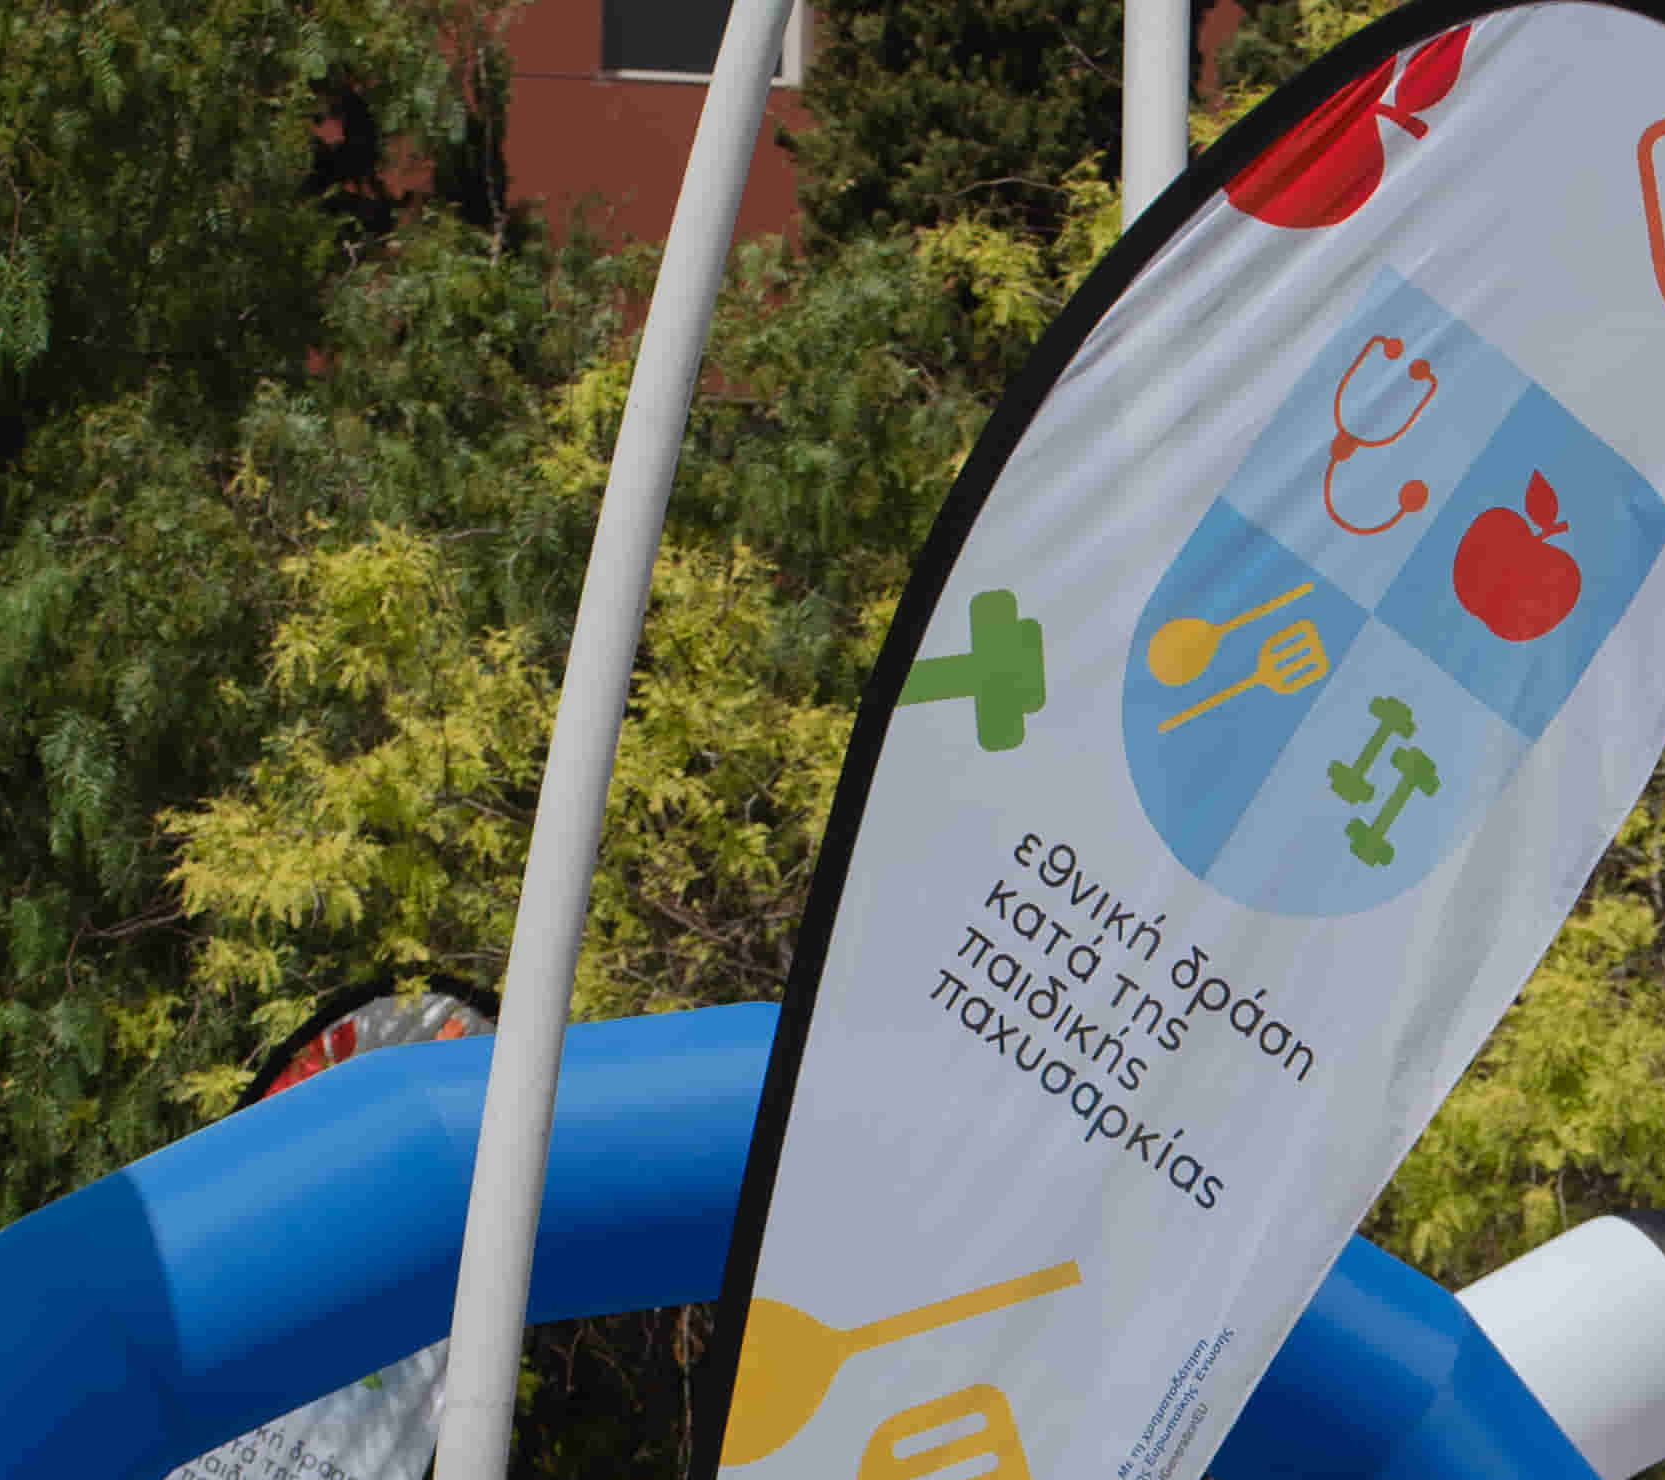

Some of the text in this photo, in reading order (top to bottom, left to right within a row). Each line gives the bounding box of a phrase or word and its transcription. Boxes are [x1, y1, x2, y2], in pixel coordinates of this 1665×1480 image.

[957, 925, 1148, 1091] παιδικής
[984, 879, 1189, 1052] κατά της
[1013, 832, 1315, 1082] εθνική δράση
[930, 968, 1225, 1210] παχυσαρκίας
